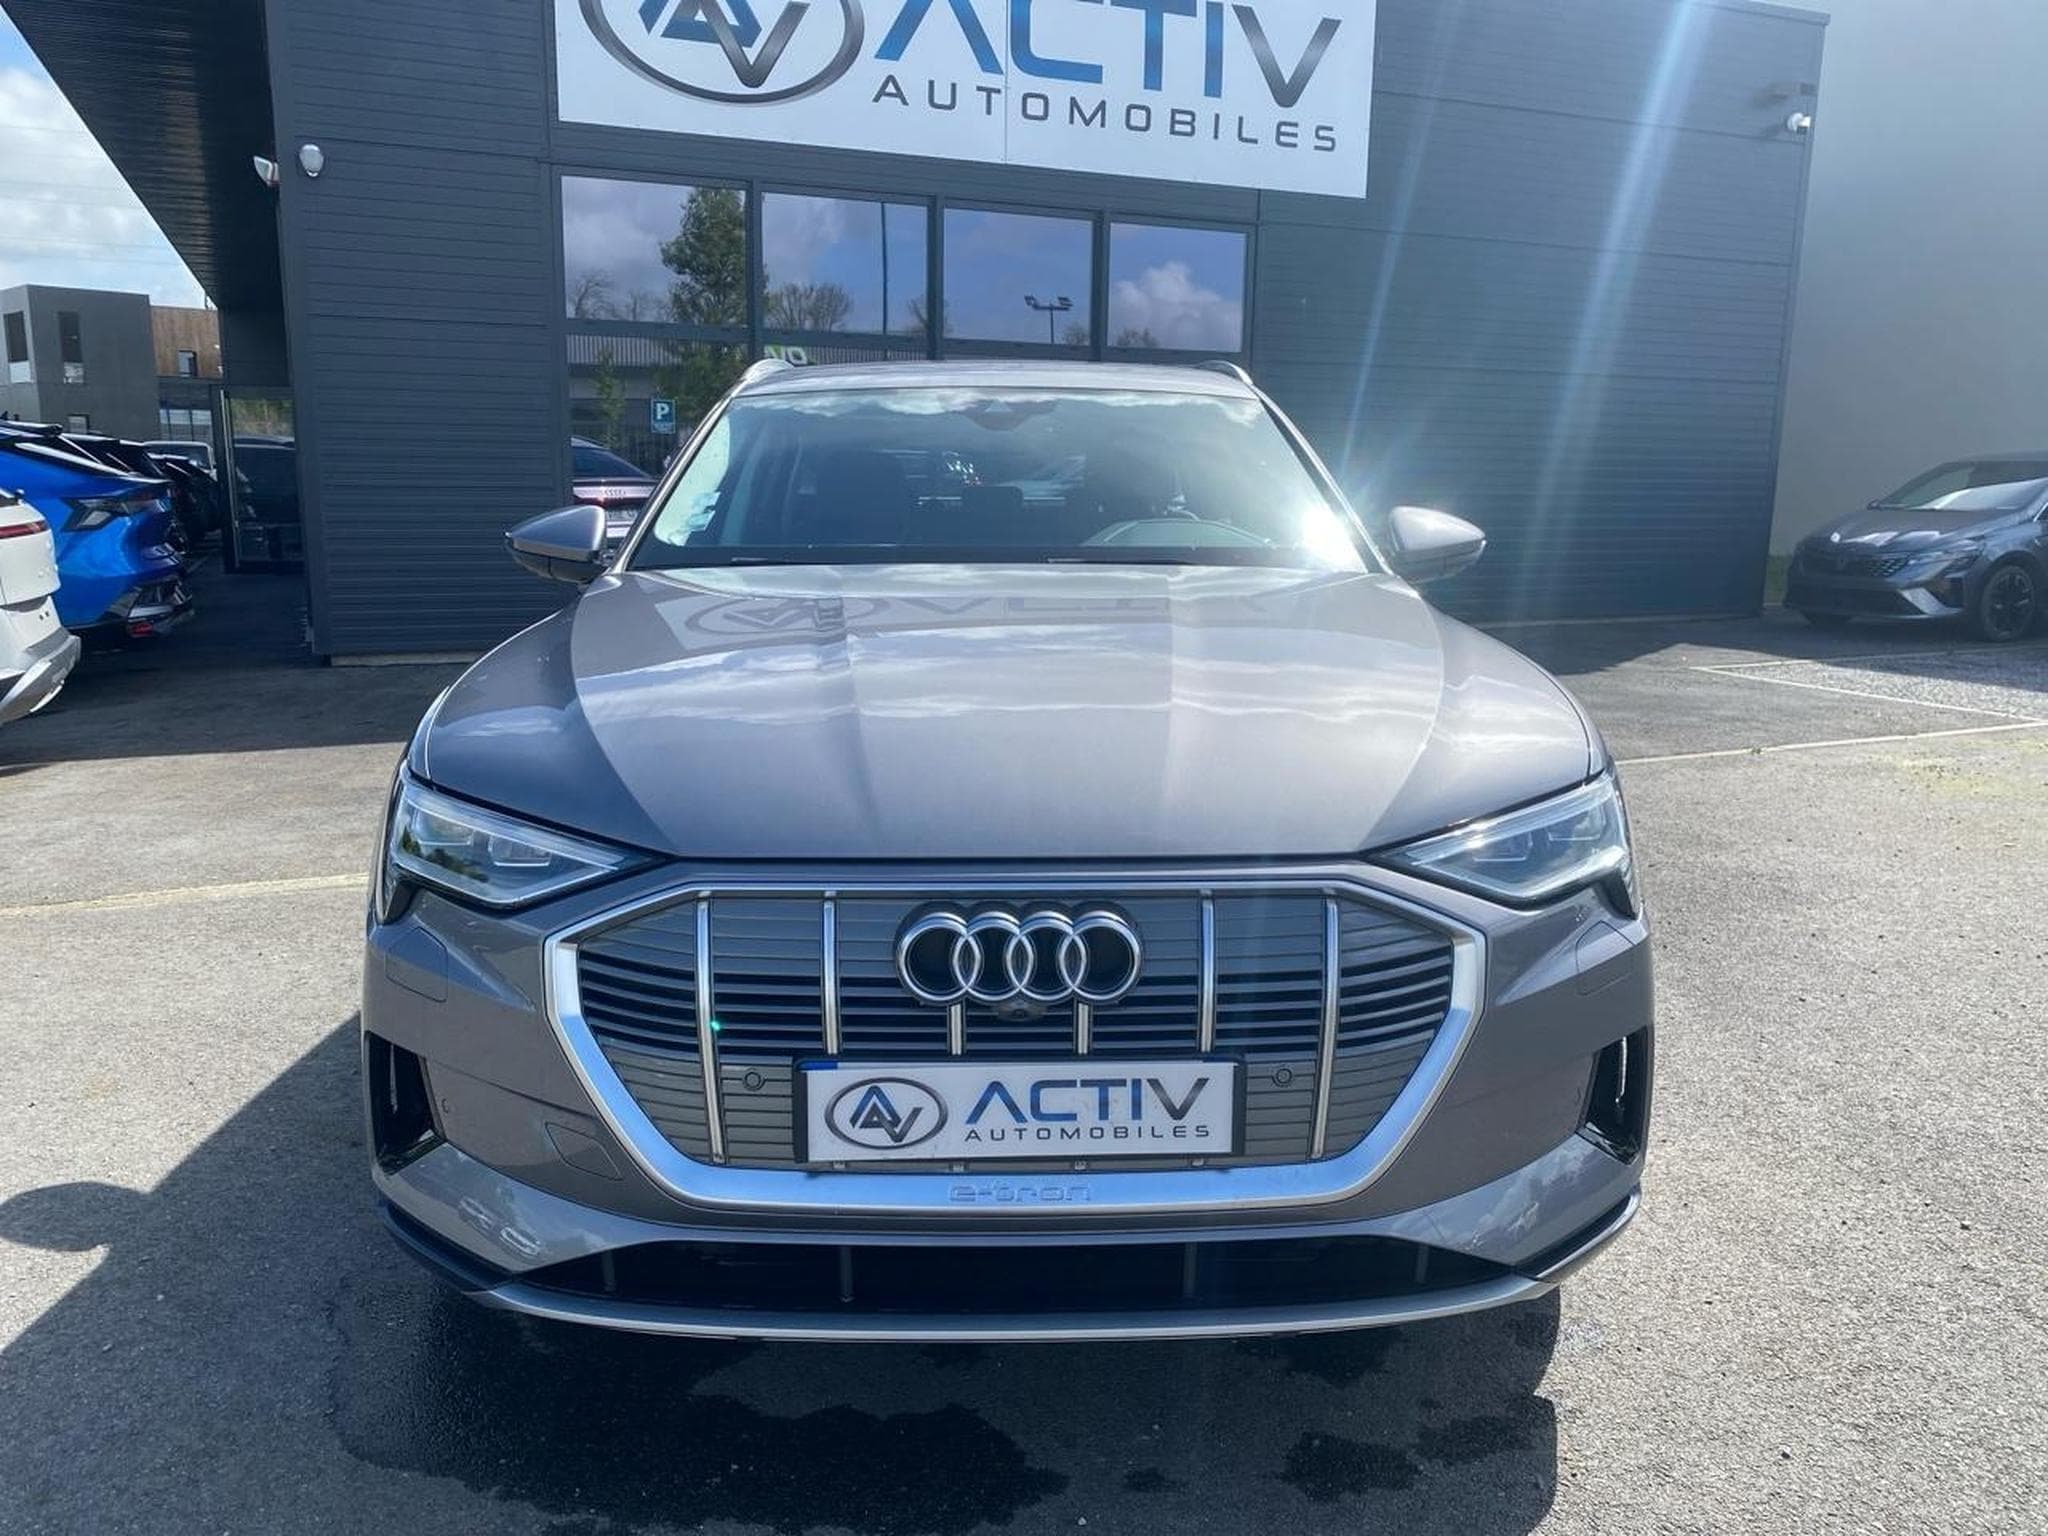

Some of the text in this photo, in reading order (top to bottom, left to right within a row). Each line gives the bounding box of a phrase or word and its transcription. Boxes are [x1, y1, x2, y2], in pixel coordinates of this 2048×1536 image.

[874, 0, 1342, 108] ACTIV
[872, 73, 1337, 153] AUTOMOBILES
[656, 402, 670, 420] P
[965, 1077, 1209, 1124] ACTIV
[964, 1125, 1210, 1143] AUTOMOBILES
[949, 1180, 1091, 1202] e-tron
